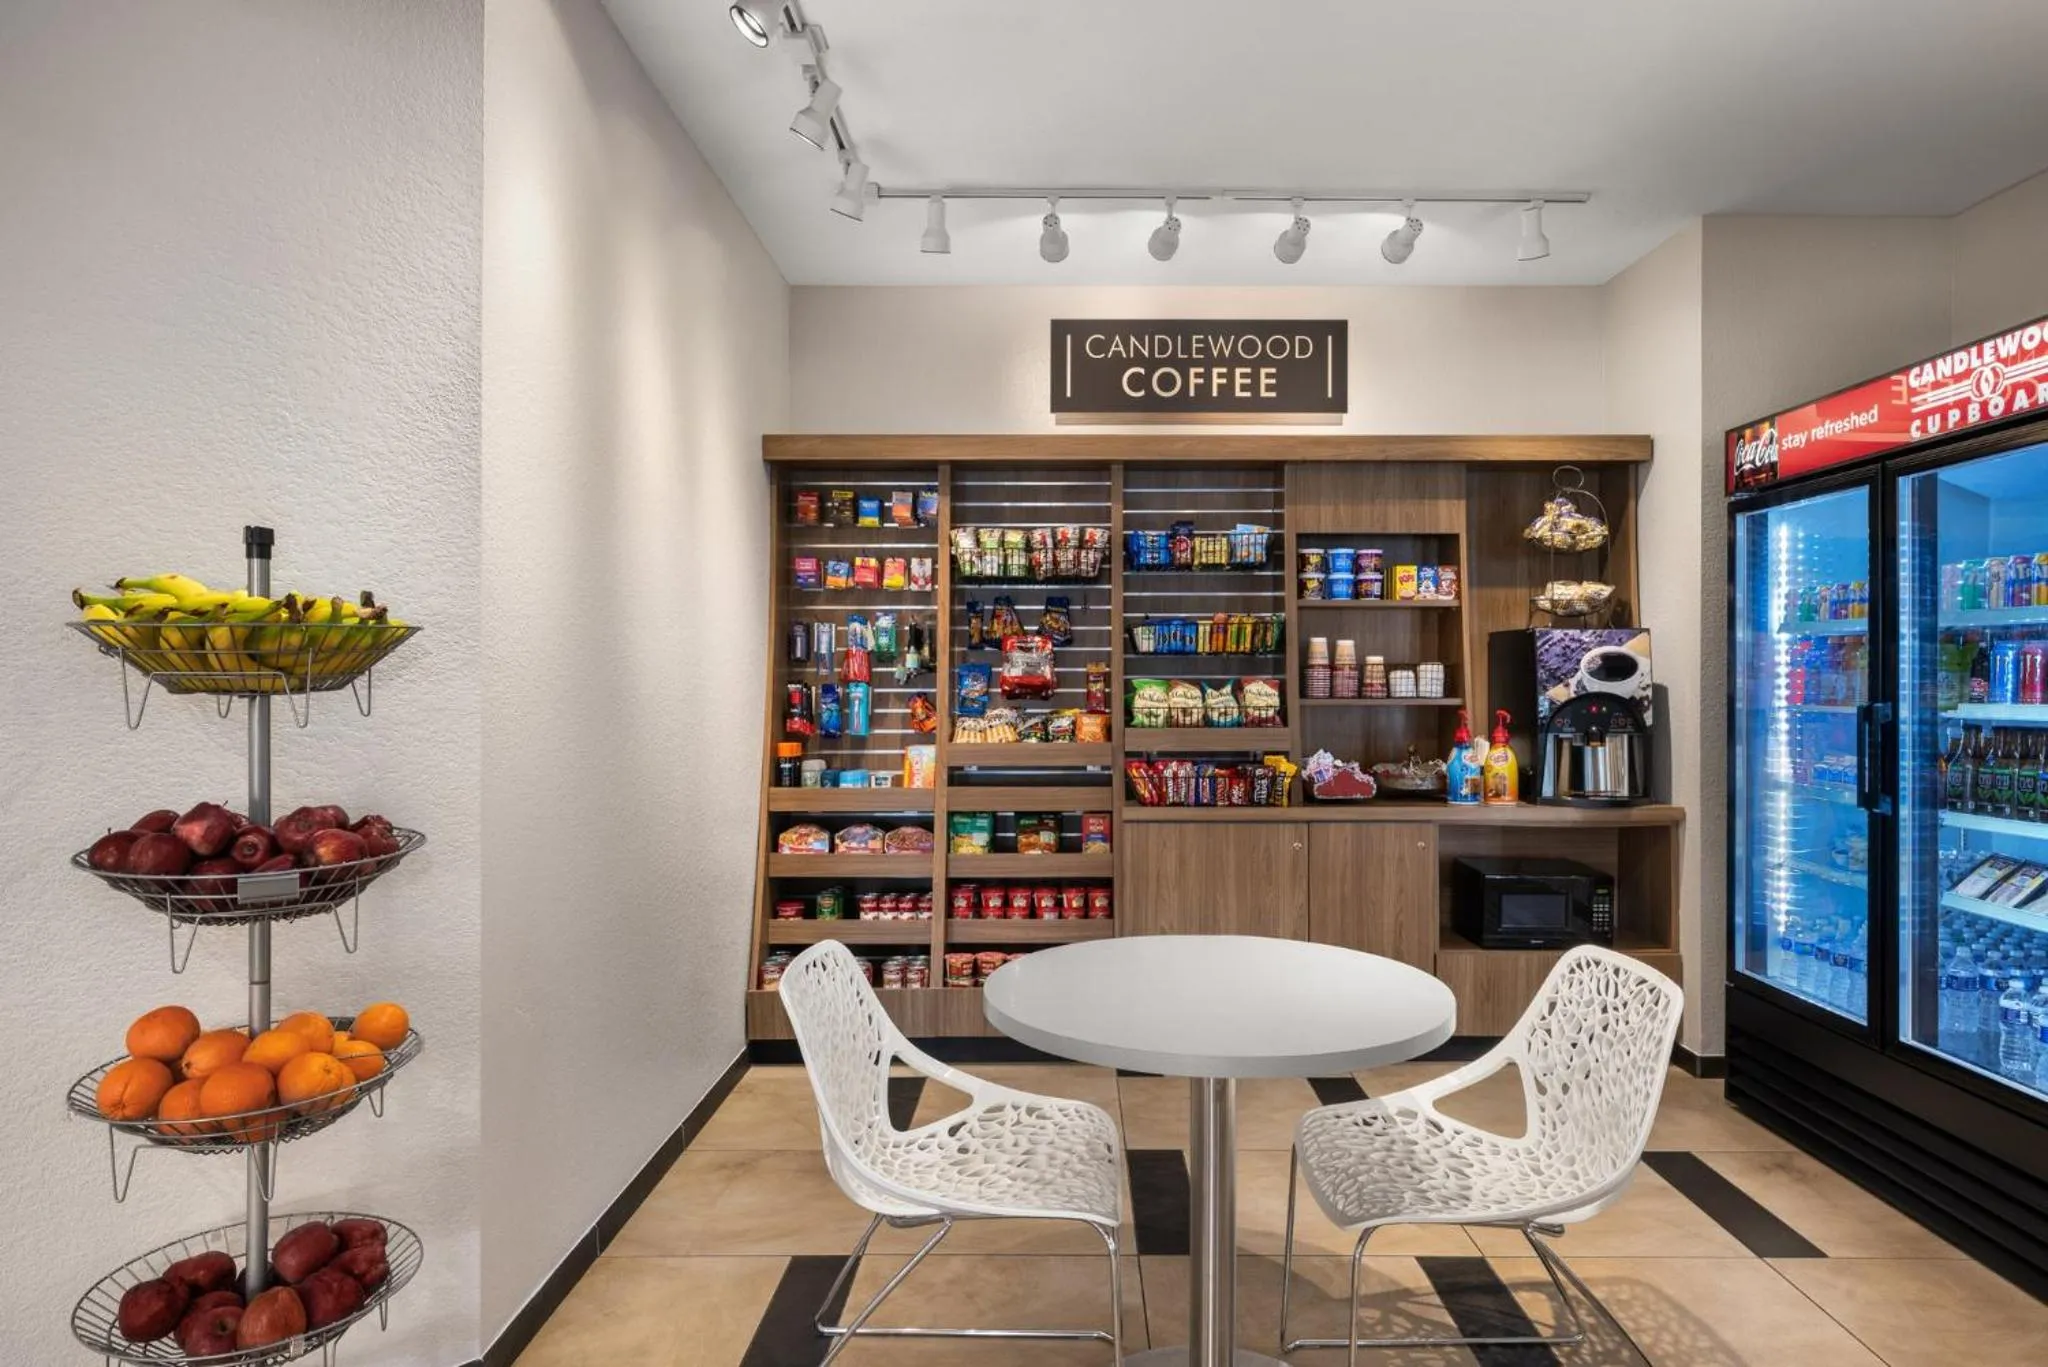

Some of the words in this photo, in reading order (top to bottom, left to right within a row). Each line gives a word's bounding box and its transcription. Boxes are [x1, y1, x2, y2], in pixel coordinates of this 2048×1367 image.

[1086, 334, 1313, 359] CANDLEWOOD
[1908, 321, 2048, 389] CANDLEWO
[1122, 366, 1278, 398] COFFEE
[1781, 430, 1808, 451] stay
[1811, 403, 1879, 442] refreshed
